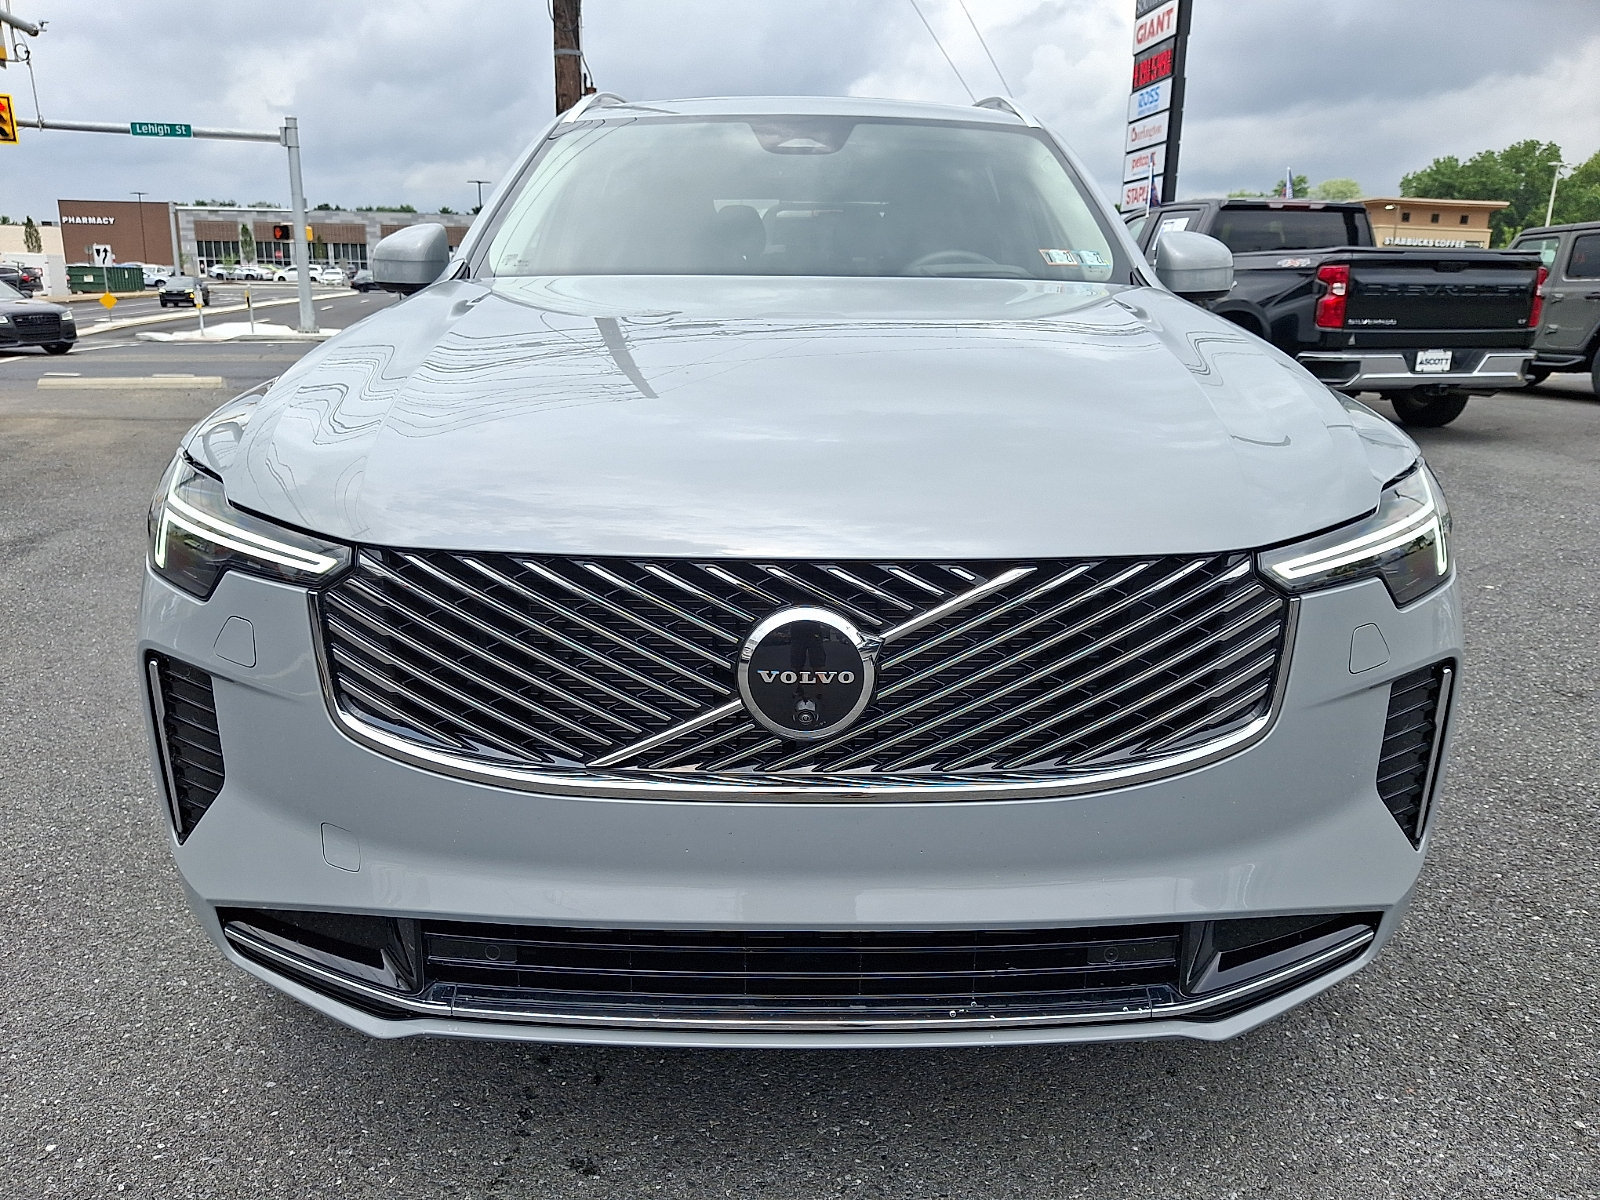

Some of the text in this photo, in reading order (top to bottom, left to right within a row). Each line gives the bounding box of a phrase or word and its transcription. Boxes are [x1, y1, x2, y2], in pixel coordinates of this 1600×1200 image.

[1136, 8, 1174, 44] GIANT
[1138, 86, 1160, 108] ROSS
[136, 123, 187, 136] Lehigh St
[61, 216, 116, 225] PHARMACY
[1384, 236, 1434, 247] STARBUCKS
[1435, 240, 1466, 248] COFFEE
[757, 670, 855, 684] VOLVO
